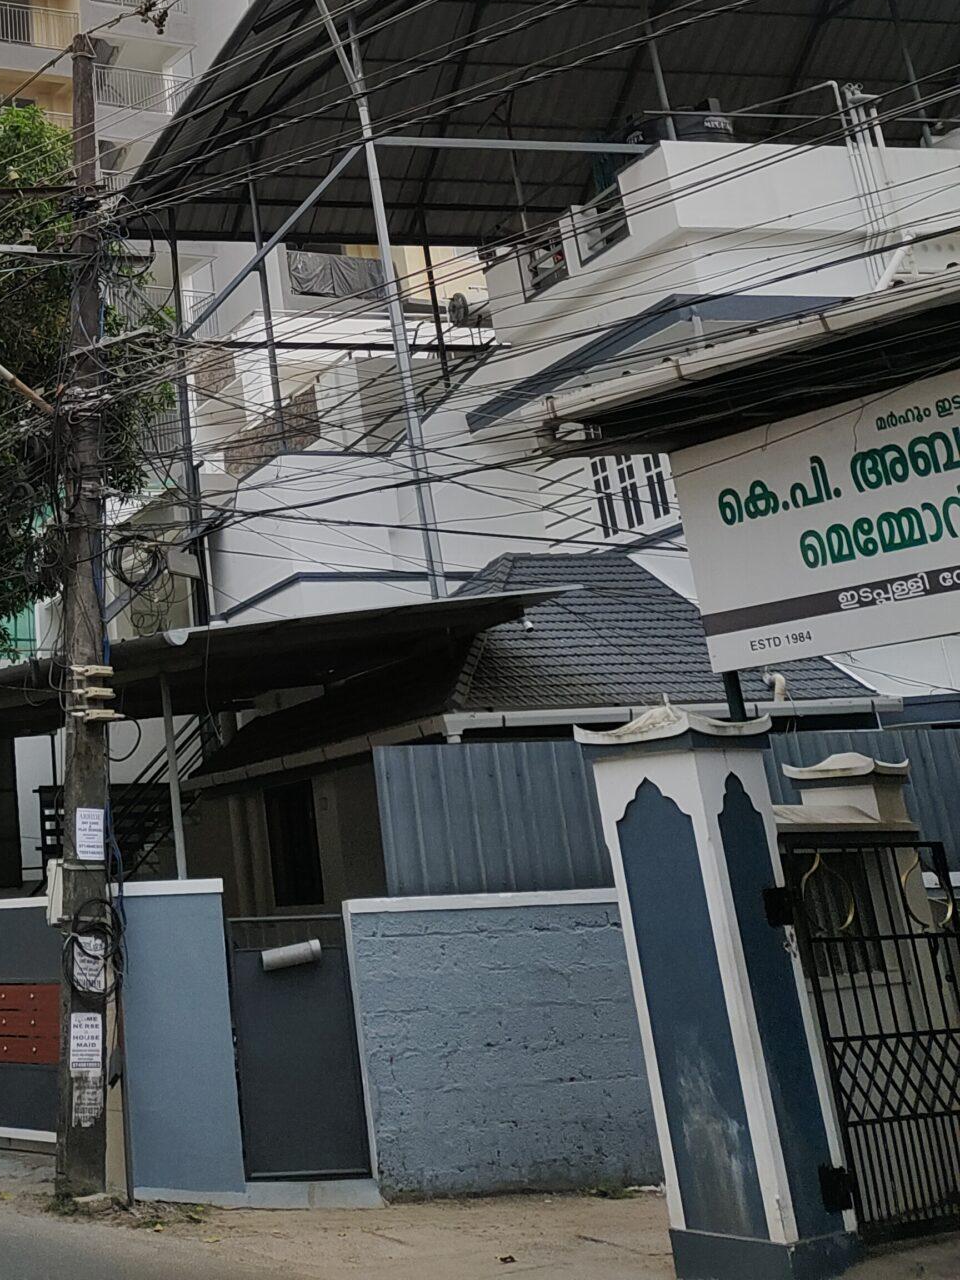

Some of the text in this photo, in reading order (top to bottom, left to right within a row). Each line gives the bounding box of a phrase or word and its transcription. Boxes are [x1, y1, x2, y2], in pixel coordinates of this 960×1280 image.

[799, 486, 960, 569] മെമ്മോറ
[750, 631, 812, 651] ESTD 1984
